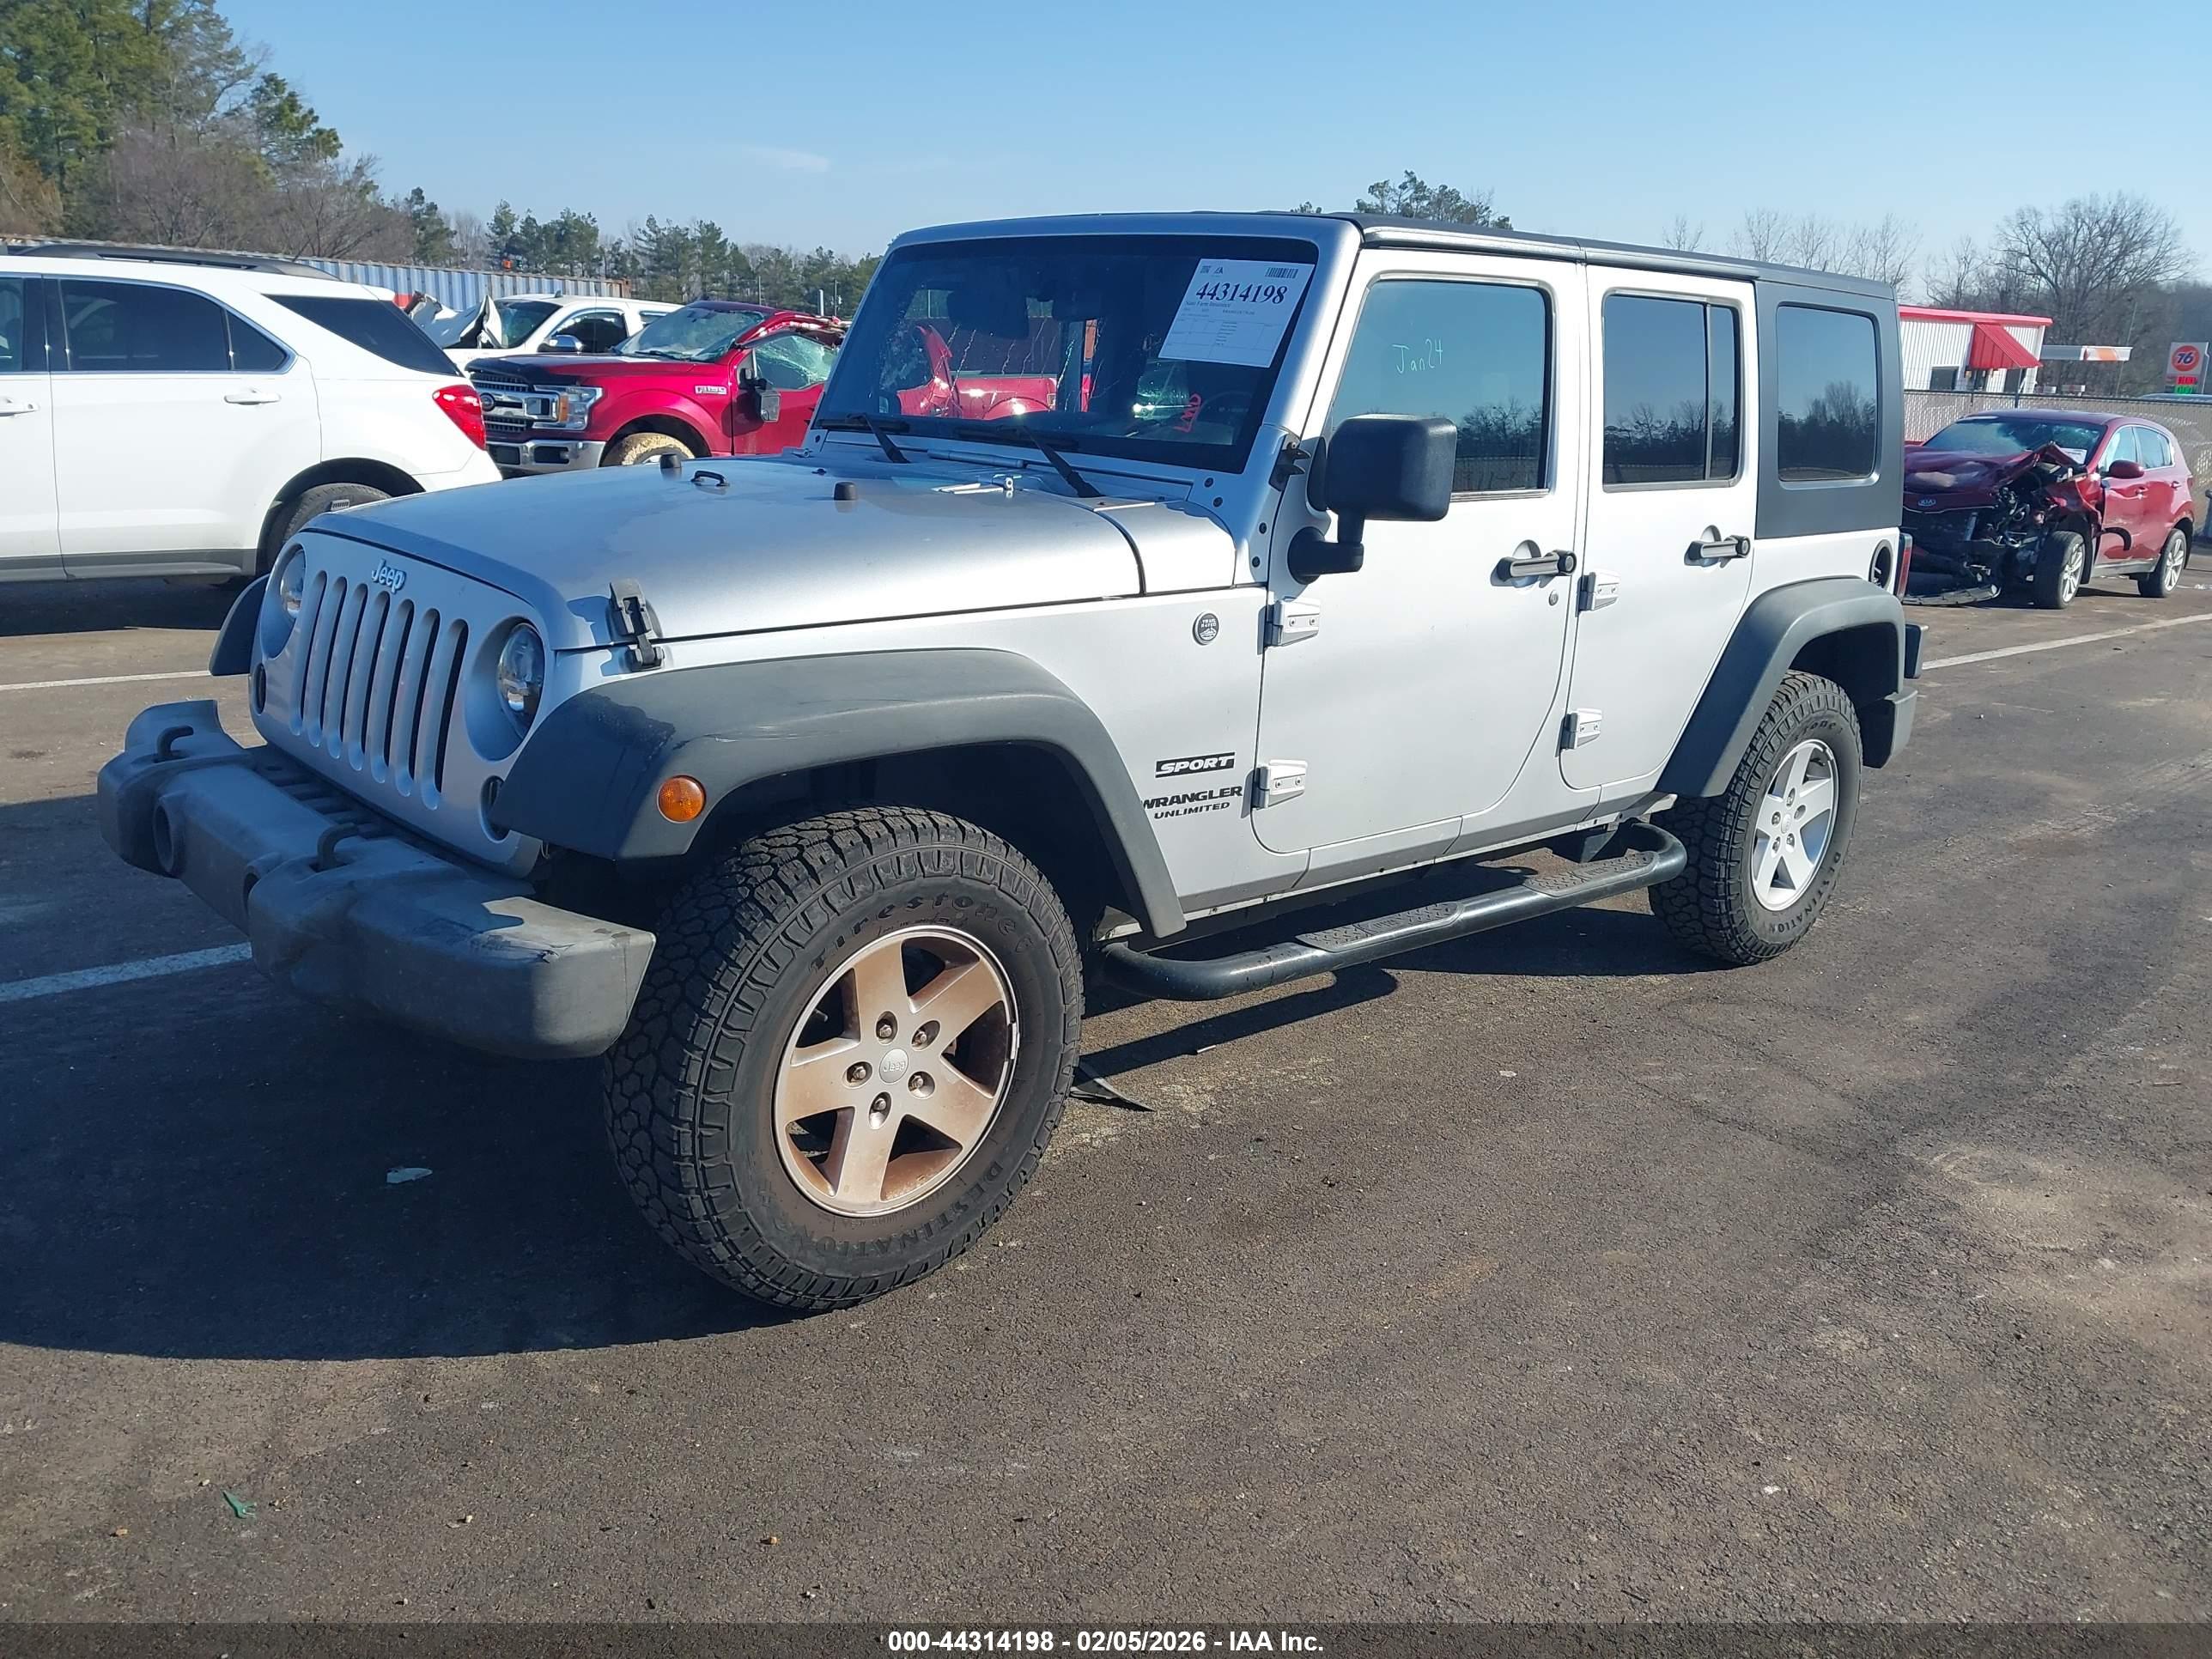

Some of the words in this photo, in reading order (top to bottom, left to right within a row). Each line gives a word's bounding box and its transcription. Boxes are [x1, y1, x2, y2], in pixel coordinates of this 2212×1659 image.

[1195, 282, 1288, 304] 44314198
[2177, 351, 2194, 364] 76
[371, 558, 406, 594] Jeep
[1158, 757, 1233, 774] SPORT
[1140, 786, 1243, 809] WRANGLER
[1154, 802, 1231, 819] UNLIMITED
[883, 1060, 906, 1073] Jeep
